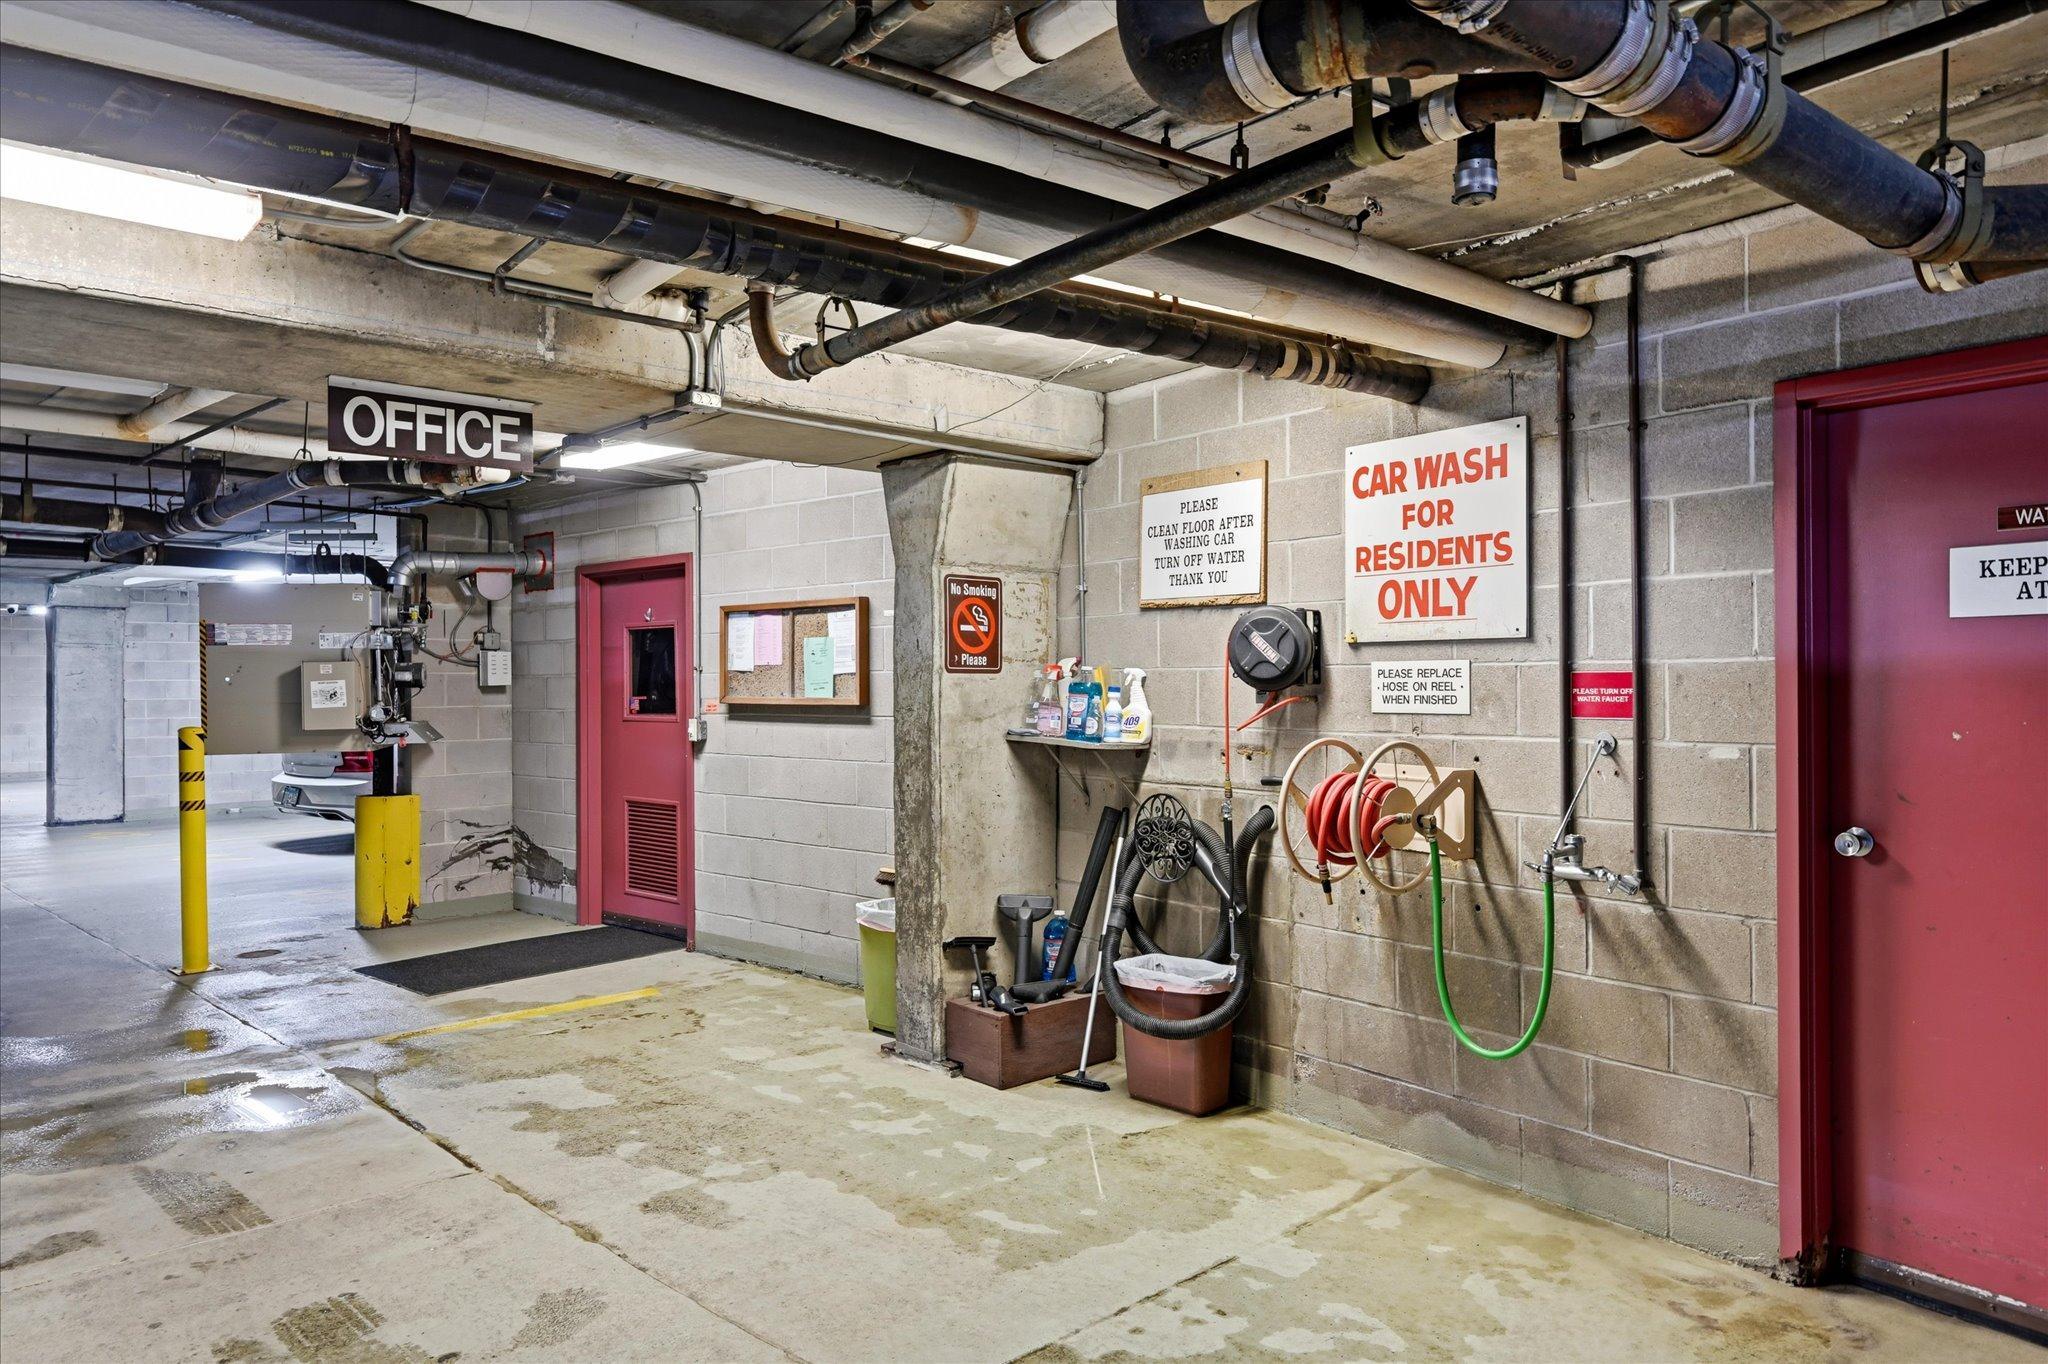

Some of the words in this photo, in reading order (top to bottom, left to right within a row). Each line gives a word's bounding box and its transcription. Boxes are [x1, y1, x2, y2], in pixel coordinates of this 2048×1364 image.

[343, 396, 521, 461] OFFICE
[1352, 460, 1407, 500] CAR
[1414, 443, 1508, 490] WASH
[1180, 498, 1218, 514] PLEASE
[1402, 499, 1454, 530] FOR
[1148, 523, 1178, 538] CLEAN
[1183, 519, 1214, 534] FLOOR
[1219, 514, 1254, 530] AFTER
[1164, 535, 1210, 550] WASHING
[1214, 532, 1234, 545] CAR
[1155, 556, 1180, 569] TURN
[1184, 554, 1203, 567] OFF
[1207, 550, 1244, 564] WATER
[1356, 531, 1513, 573] RESIDENTS
[1980, 556, 2048, 578] KEEP
[1169, 572, 1203, 586] THANK
[1208, 571, 1228, 583] YOU
[951, 583, 961, 594] No
[963, 584, 996, 599] Smoking
[1378, 576, 1478, 619] ONLY
[962, 654, 987, 665] Please
[1378, 669, 1412, 678] PLEASE
[1417, 668, 1462, 678] REPLACE
[1383, 682, 1408, 691] HOSE
[1413, 682, 1427, 691] ON
[1431, 682, 1456, 691] REEL
[1382, 695, 1410, 704] WHEN
[1414, 695, 1457, 704] FINISHED
[1124, 717, 1139, 726] 409
